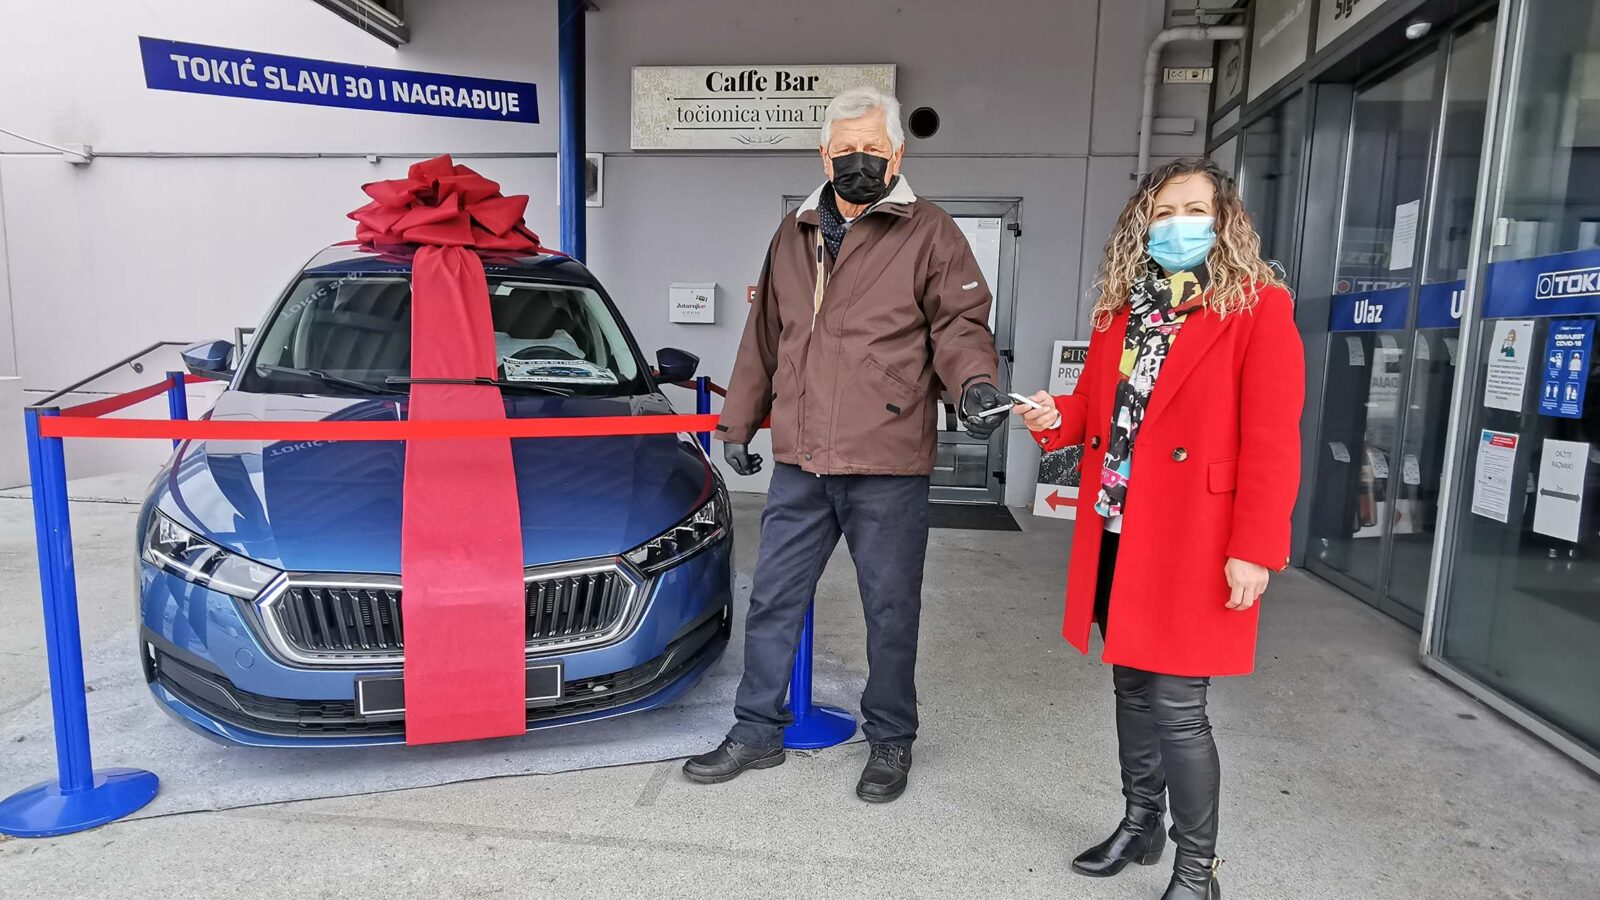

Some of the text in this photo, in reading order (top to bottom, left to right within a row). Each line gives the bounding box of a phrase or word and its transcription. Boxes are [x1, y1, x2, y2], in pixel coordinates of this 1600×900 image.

[170, 54, 520, 115] TOKIĆ SLAVI 30 I NAGRAĐUJE
[705, 70, 820, 92] Caffe Bar
[677, 104, 760, 123] točionica
[765, 104, 804, 122] vina
[1353, 299, 1384, 324] Ulaz
[1450, 290, 1466, 319] U
[1058, 367, 1080, 379] PRO
